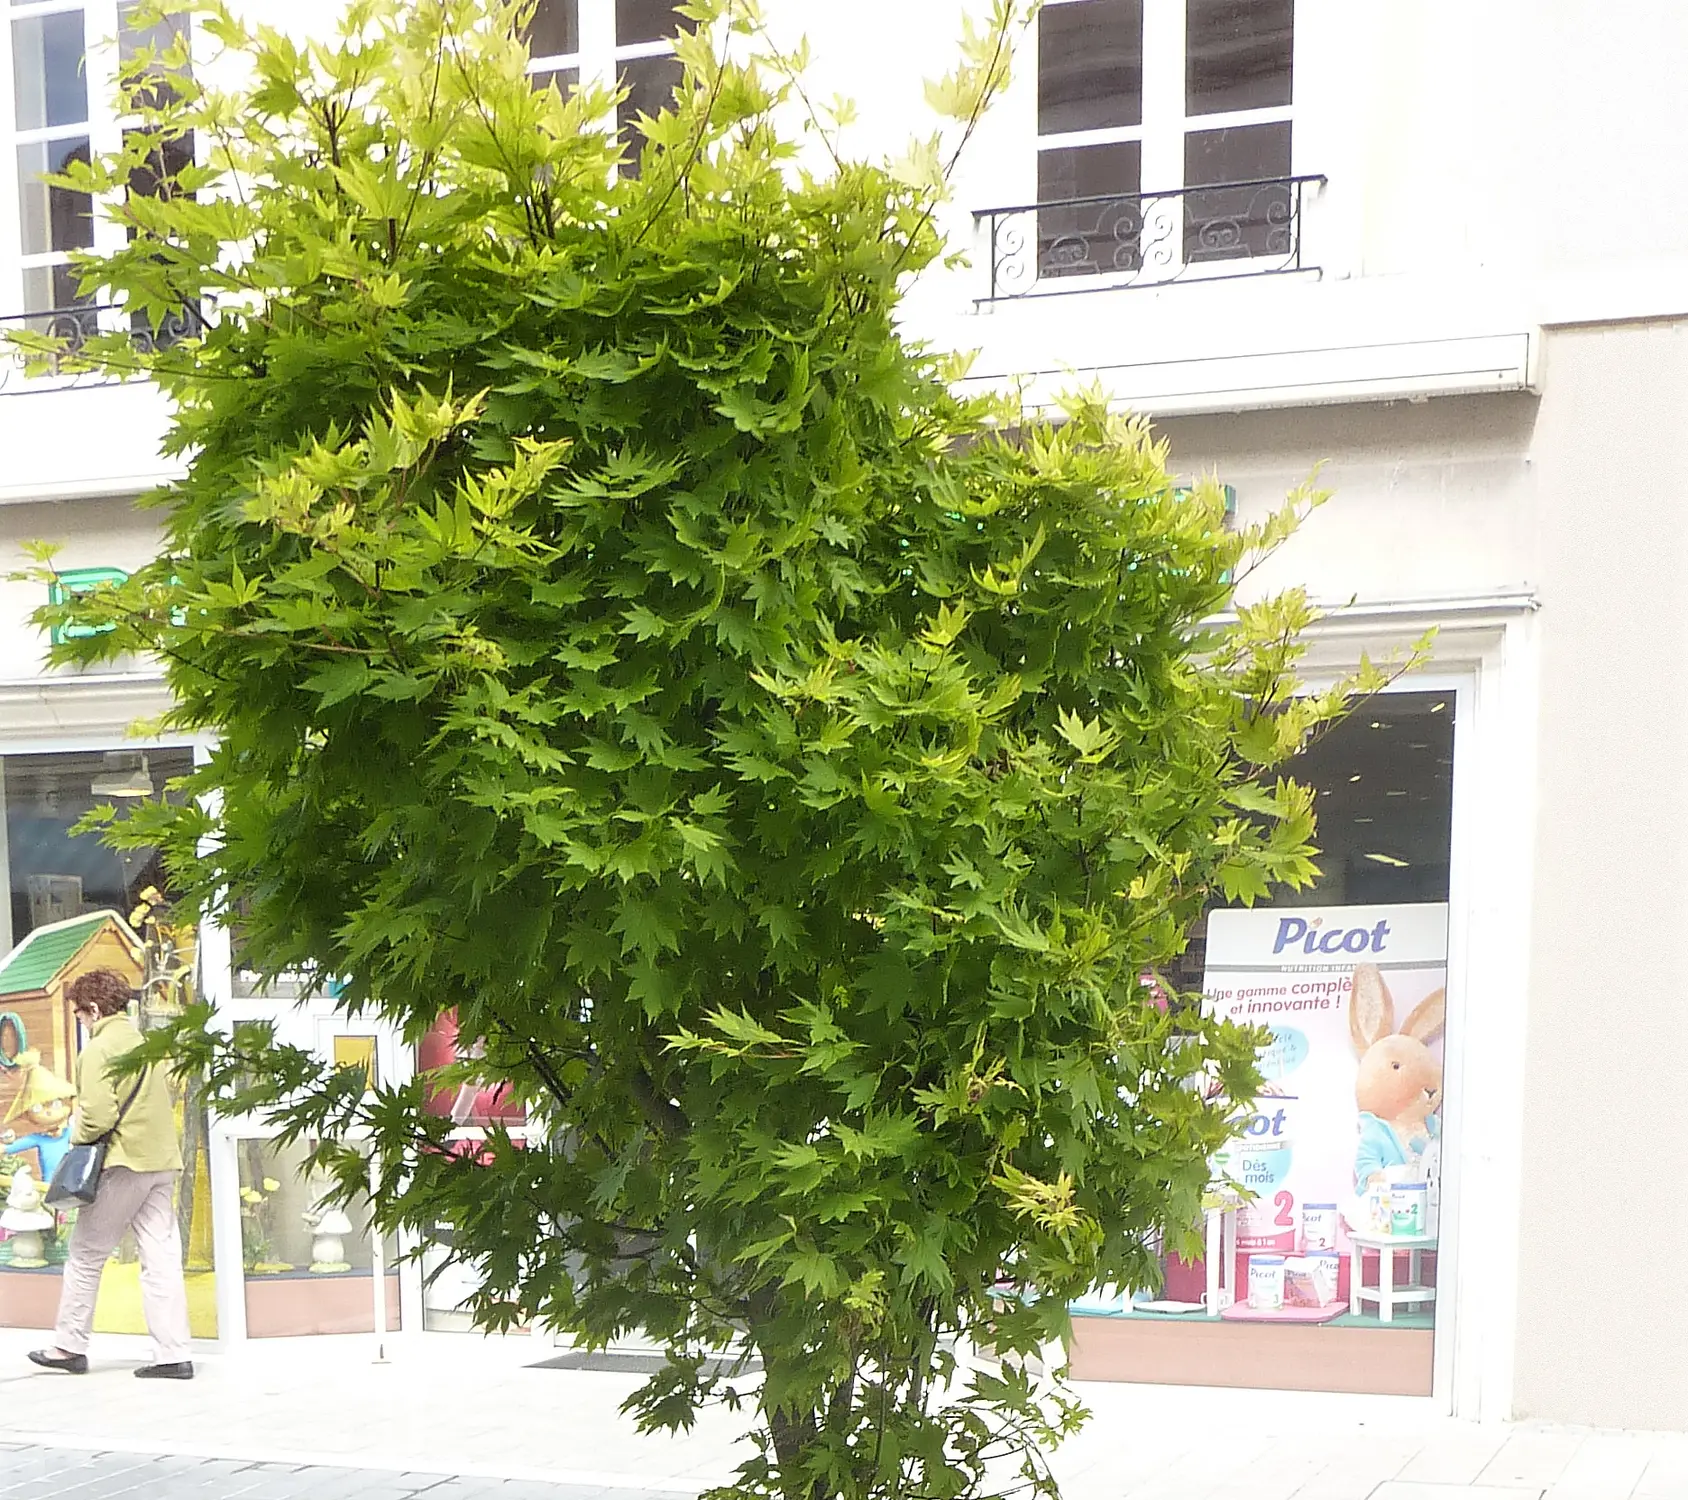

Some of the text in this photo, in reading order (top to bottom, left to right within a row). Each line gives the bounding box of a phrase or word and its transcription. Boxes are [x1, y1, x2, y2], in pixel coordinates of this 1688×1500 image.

[1272, 916, 1391, 955] Picot
[1280, 963, 1329, 973] NUTRITION
[1206, 987, 1233, 1003] Une
[1237, 985, 1287, 1001] gamme
[1230, 995, 1341, 1015] et innovante !
[1242, 1158, 1267, 1172] Dès
[1245, 1170, 1275, 1184] mois
[1273, 1190, 1294, 1227] 2
[1319, 1237, 1326, 1247] 2
[1250, 1267, 1277, 1279] Picot
